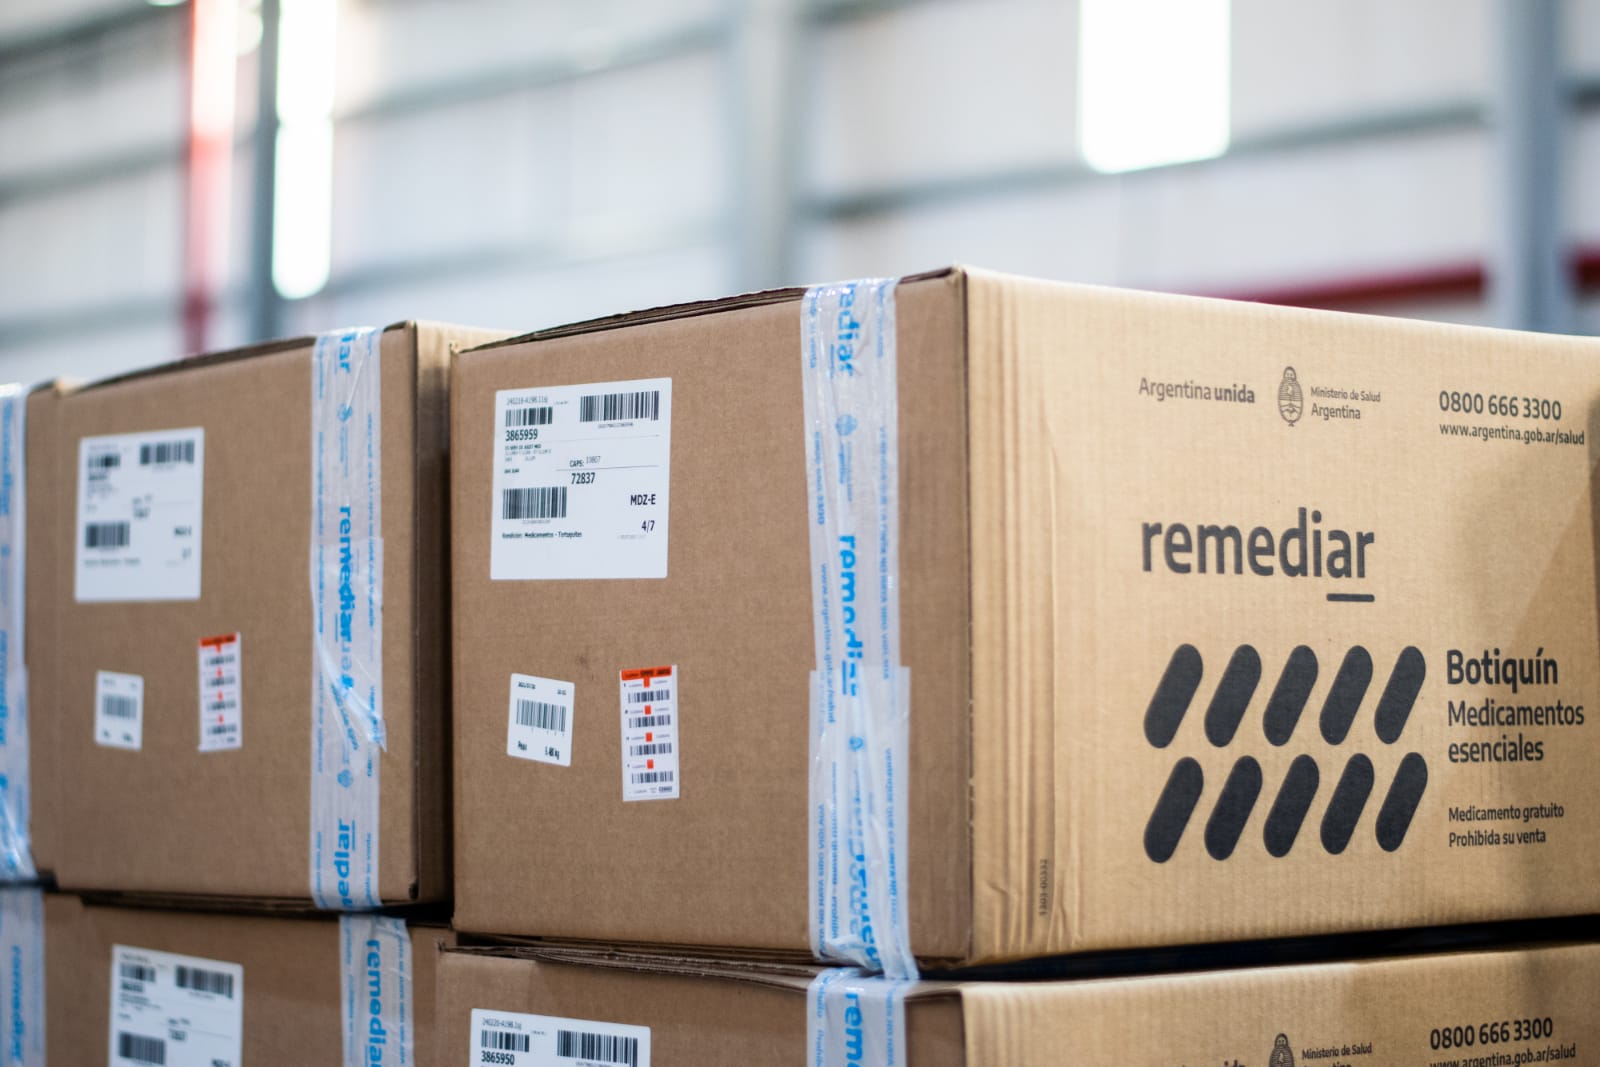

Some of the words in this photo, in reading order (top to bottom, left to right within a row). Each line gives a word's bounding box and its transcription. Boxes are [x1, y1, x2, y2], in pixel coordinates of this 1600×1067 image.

[1138, 377, 1212, 401] Argentina
[1214, 383, 1256, 403] unida
[1310, 386, 1348, 400] Ministerio
[1349, 389, 1359, 401] de
[1360, 391, 1381, 403] Salud
[1311, 402, 1361, 421] Argentina
[1439, 390, 1484, 415] 0800
[1488, 394, 1519, 417] 666
[1522, 397, 1562, 421] 3300
[505, 428, 539, 442] 3865959
[1439, 423, 1585, 446] www.argentina.gob.ar/salud
[570, 471, 596, 485] 72837
[630, 493, 657, 506] MDZ-E
[641, 519, 656, 533] 4/7
[1142, 507, 1376, 579] remediar
[1447, 647, 1558, 694] Botiquín
[1447, 697, 1585, 727] Medicamentos
[1448, 732, 1544, 763] esenciales
[1448, 804, 1521, 822] Medicamento
[1522, 802, 1565, 823] gratuito
[1449, 828, 1501, 848] Prohibida
[1502, 834, 1515, 846] su
[1517, 828, 1547, 845] venta
[1430, 1024, 1476, 1050] 0800
[1479, 1021, 1511, 1045] 666
[1513, 1017, 1554, 1041] 3300
[481, 1050, 515, 1066] 3865950
[1301, 1045, 1339, 1060] Ministerio
[1340, 1044, 1350, 1056] de
[1351, 1042, 1373, 1055] Salud
